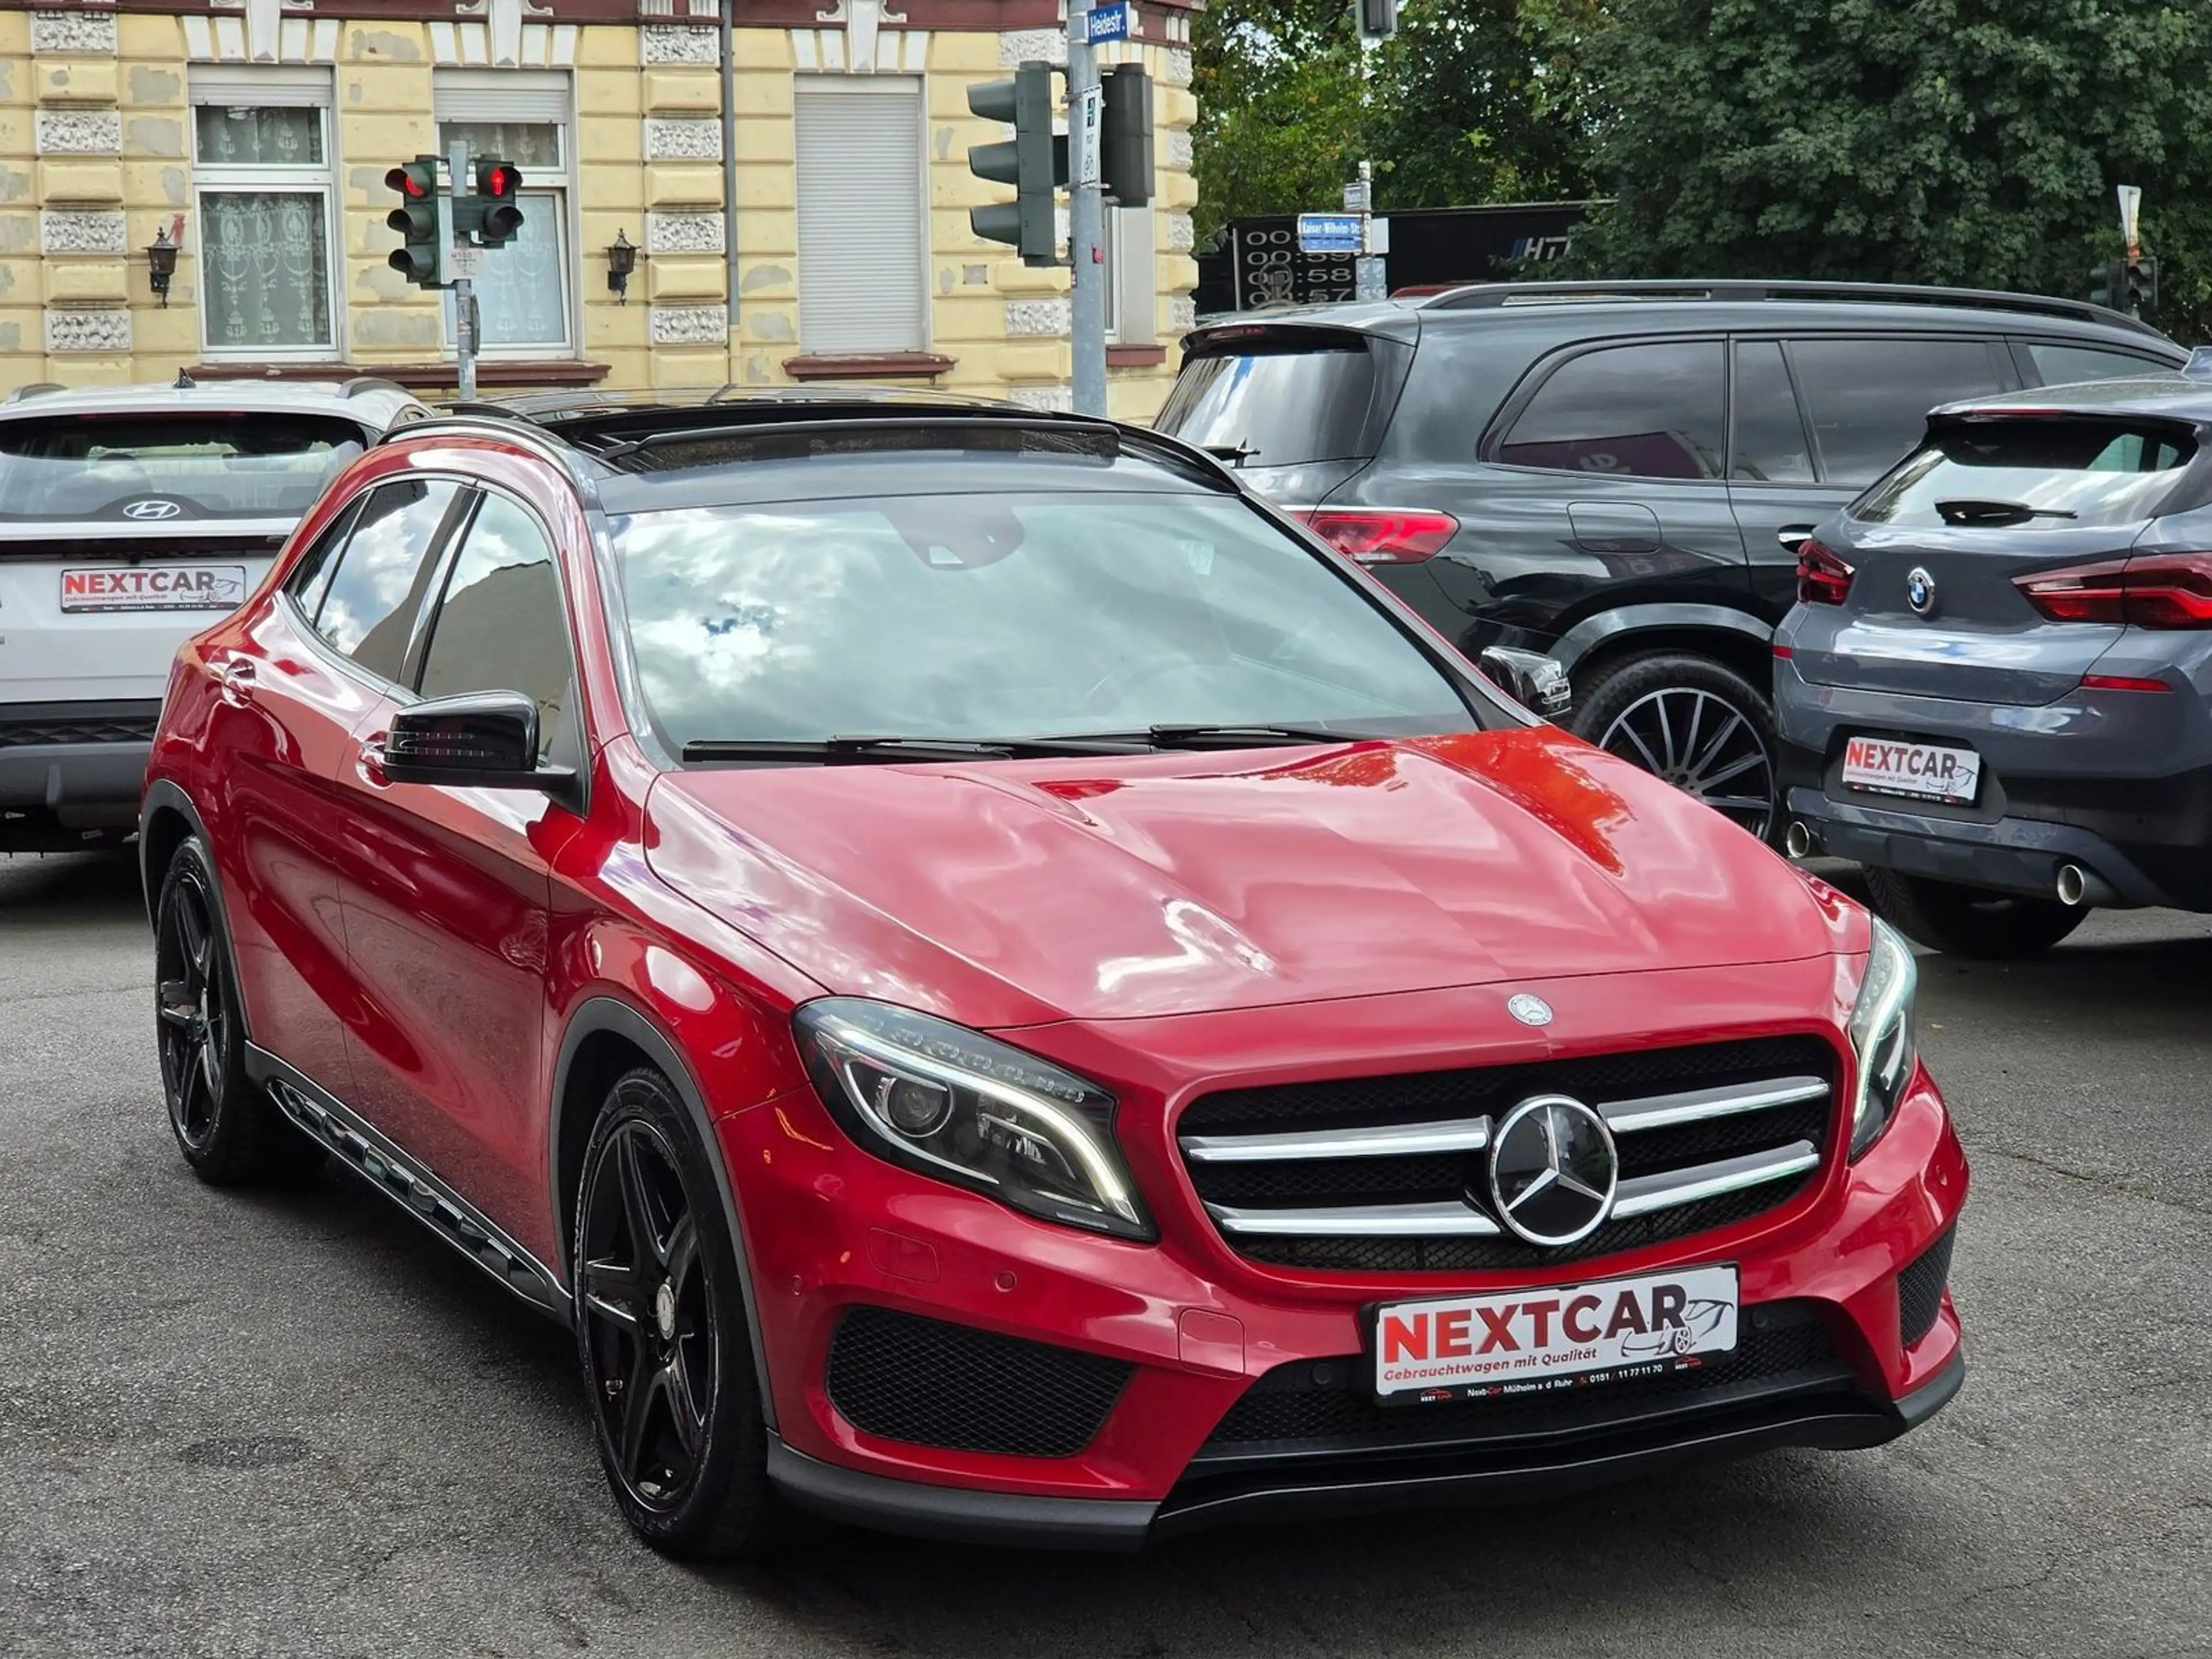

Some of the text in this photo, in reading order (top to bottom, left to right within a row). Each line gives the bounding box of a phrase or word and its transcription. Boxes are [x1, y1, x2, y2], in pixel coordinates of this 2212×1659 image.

[1090, 9, 1126, 38] Heidestr.
[65, 571, 215, 594] NEXTCAR
[1847, 741, 1957, 779] NEXTCAR
[1384, 1285, 1687, 1363] NEXTCAR
[1384, 1347, 1597, 1381] Gebrauchtwagen mit Qualität
[1554, 1380, 1573, 1388] Ruhr
